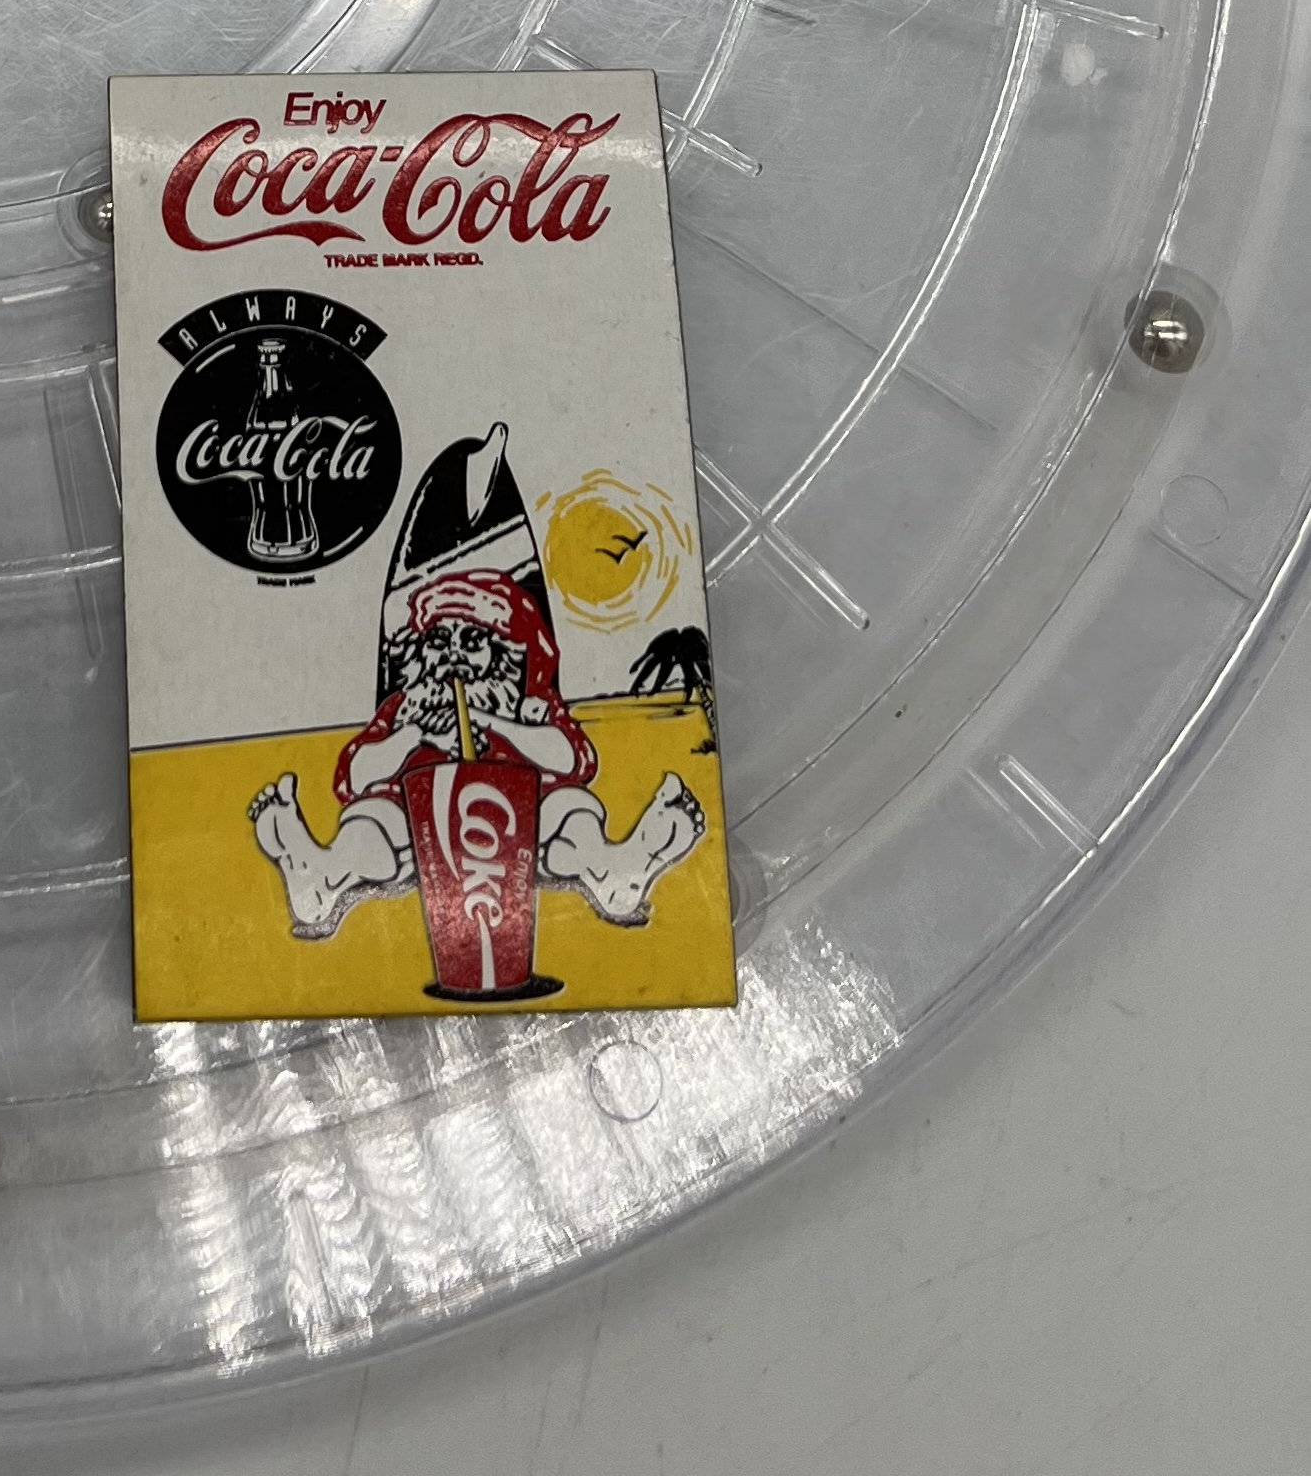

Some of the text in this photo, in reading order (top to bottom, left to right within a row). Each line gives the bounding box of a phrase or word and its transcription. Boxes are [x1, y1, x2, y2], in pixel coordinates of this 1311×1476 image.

[283, 91, 387, 134] Enjoy
[161, 112, 621, 252] Coca-Cola
[323, 253, 379, 268] TRADE
[382, 253, 430, 267] MARK
[178, 295, 368, 349] ALWAYS
[176, 414, 378, 484] Coca-Cola
[457, 782, 517, 928] Coke
[513, 847, 533, 902] Enjoy
